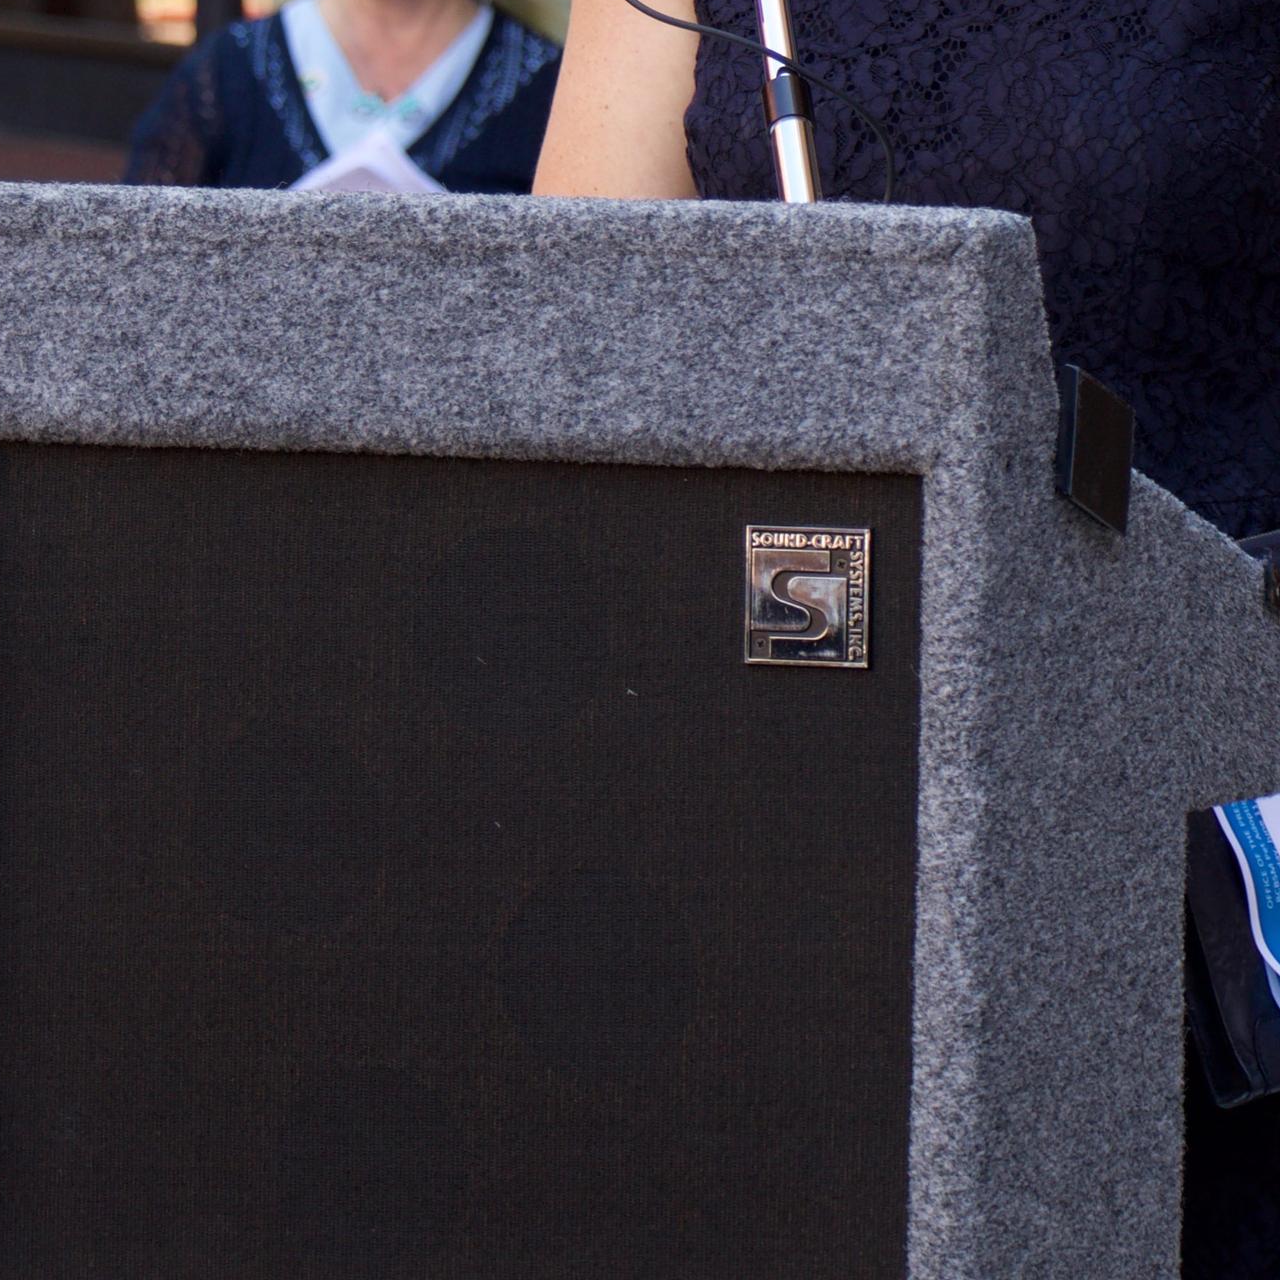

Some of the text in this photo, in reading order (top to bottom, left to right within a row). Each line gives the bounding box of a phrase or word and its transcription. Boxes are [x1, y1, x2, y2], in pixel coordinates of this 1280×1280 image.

[751, 532, 864, 550] SOUND-CRAFT
[1243, 829, 1256, 849] THE
[1254, 852, 1264, 867] OF
[1260, 870, 1273, 909] OFFICE
